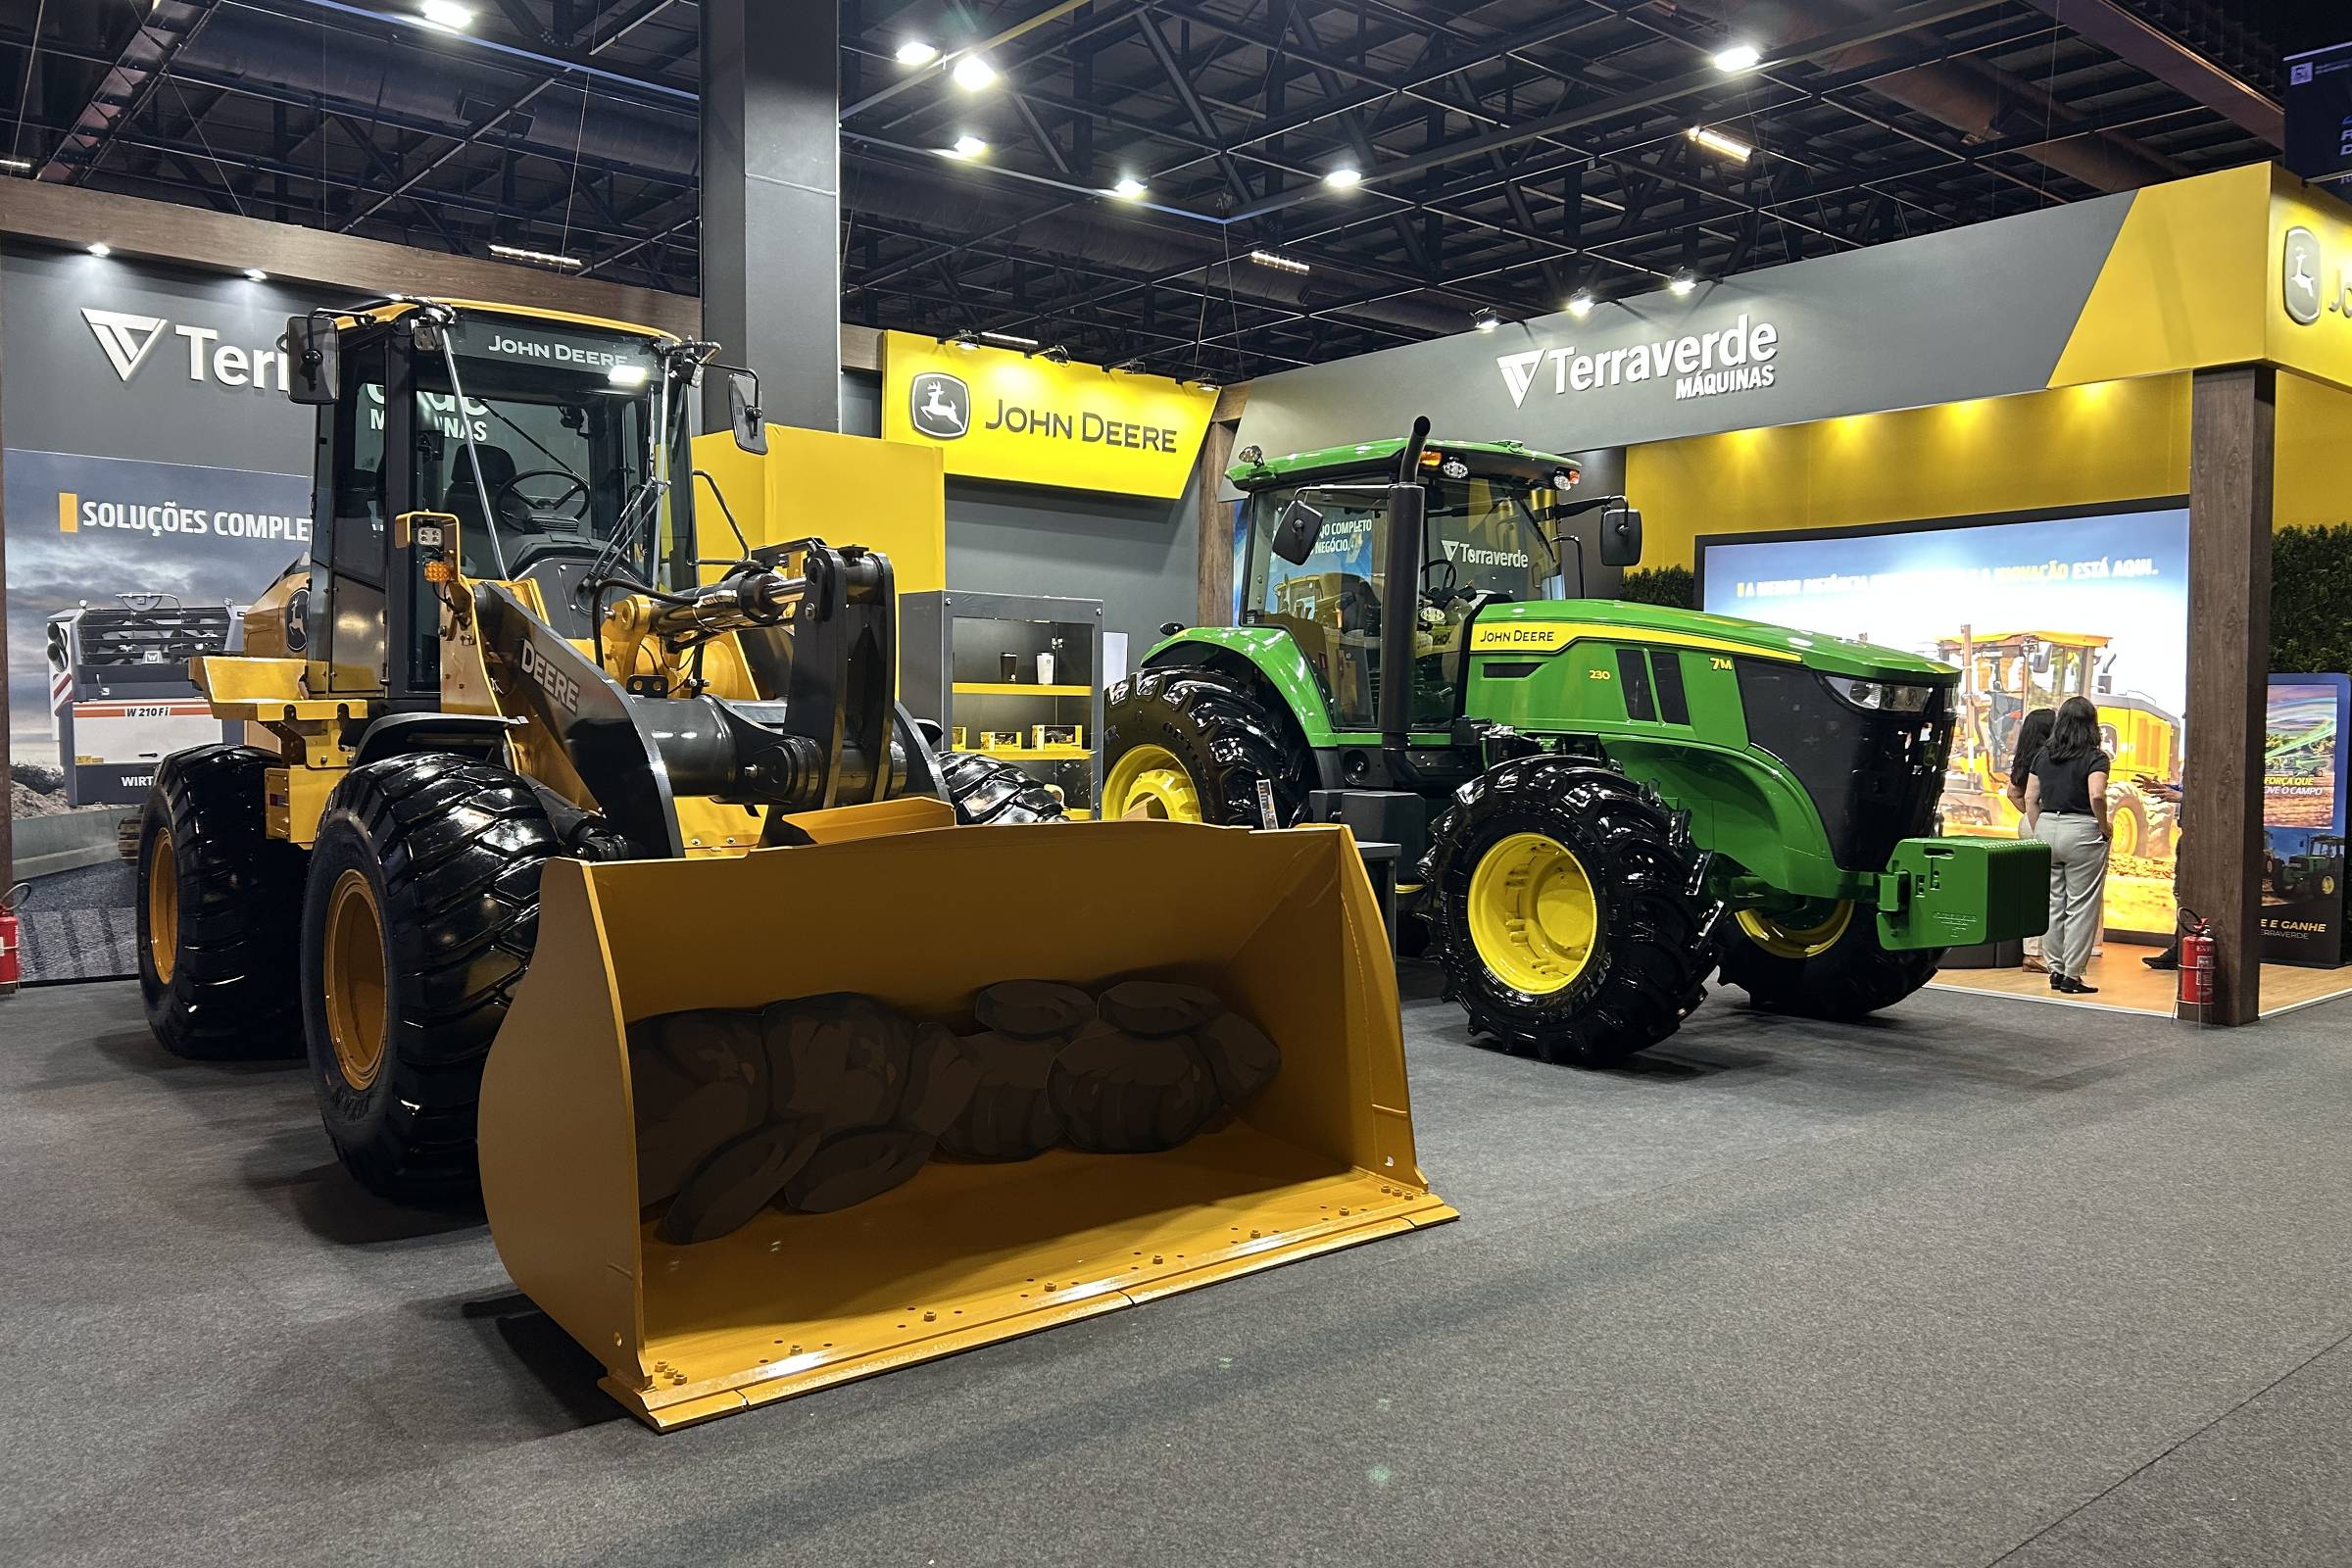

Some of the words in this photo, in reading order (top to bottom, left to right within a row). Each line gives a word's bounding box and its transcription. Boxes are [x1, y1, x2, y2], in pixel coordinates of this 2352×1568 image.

[488, 335, 551, 359] JOHN
[1547, 314, 1779, 394] Terraverde
[1675, 365, 1775, 401] MÁQUINAS
[985, 399, 1072, 439] JOHN
[1082, 412, 1177, 453] DEERE
[82, 501, 207, 537] SOLUÇÕES
[214, 511, 314, 542] COMPLE
[1331, 518, 1372, 535] COMPLETO
[1459, 543, 1529, 568] Terraverde
[2072, 556, 2110, 580] ESTÁ
[1480, 630, 1511, 643] JOHN
[1513, 630, 1555, 642] DEERE
[520, 638, 580, 714] DEERE
[1589, 670, 1611, 680] 230
[1709, 658, 1733, 670] 7M
[2294, 777, 2314, 786] QUE
[2270, 919, 2279, 928] E
[2280, 920, 2328, 933] GANHE
